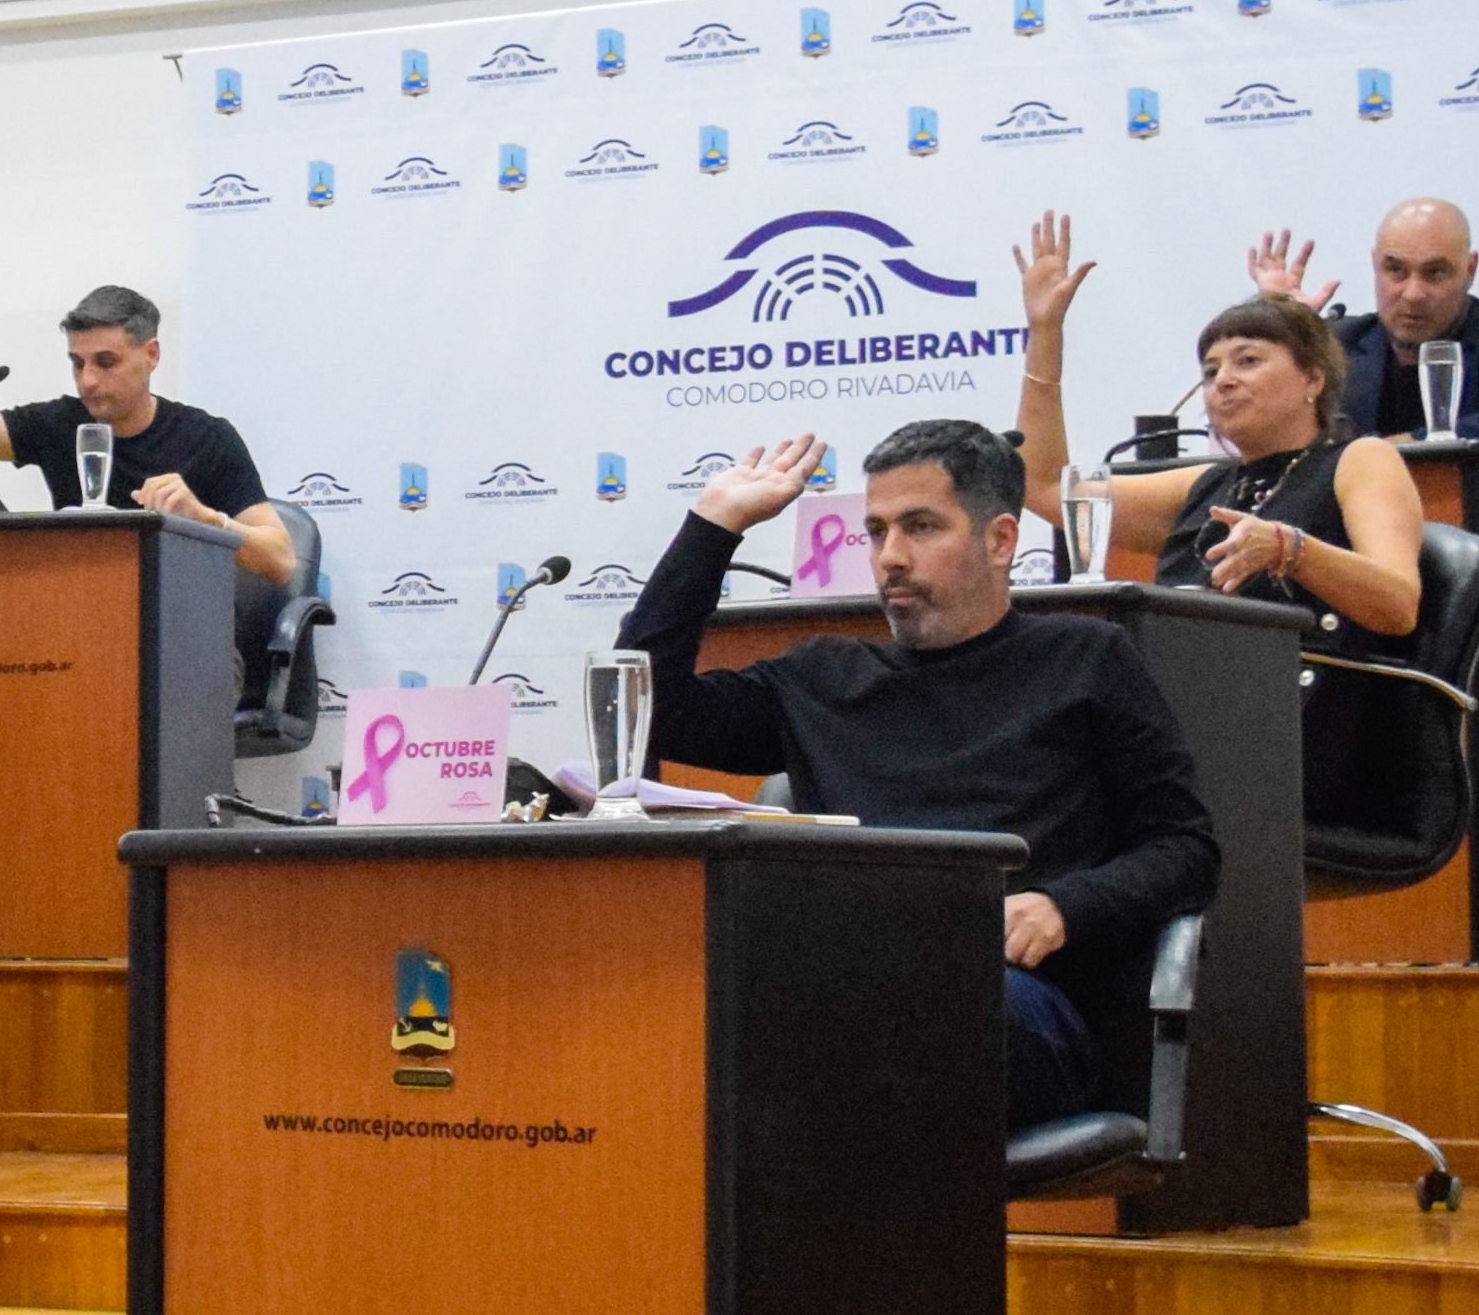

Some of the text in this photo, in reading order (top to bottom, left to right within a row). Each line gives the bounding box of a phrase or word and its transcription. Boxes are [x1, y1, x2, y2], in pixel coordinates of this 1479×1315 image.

[604, 342, 773, 379] CONCEJO
[666, 370, 975, 408] COMODORO RIVADAVIA
[504, 488, 558, 497] DELIBERANTE
[405, 739, 495, 759] OCTUBRE
[440, 761, 492, 779] ROSA
[263, 1114, 597, 1148] www.concejocomodoro.gob.ar
